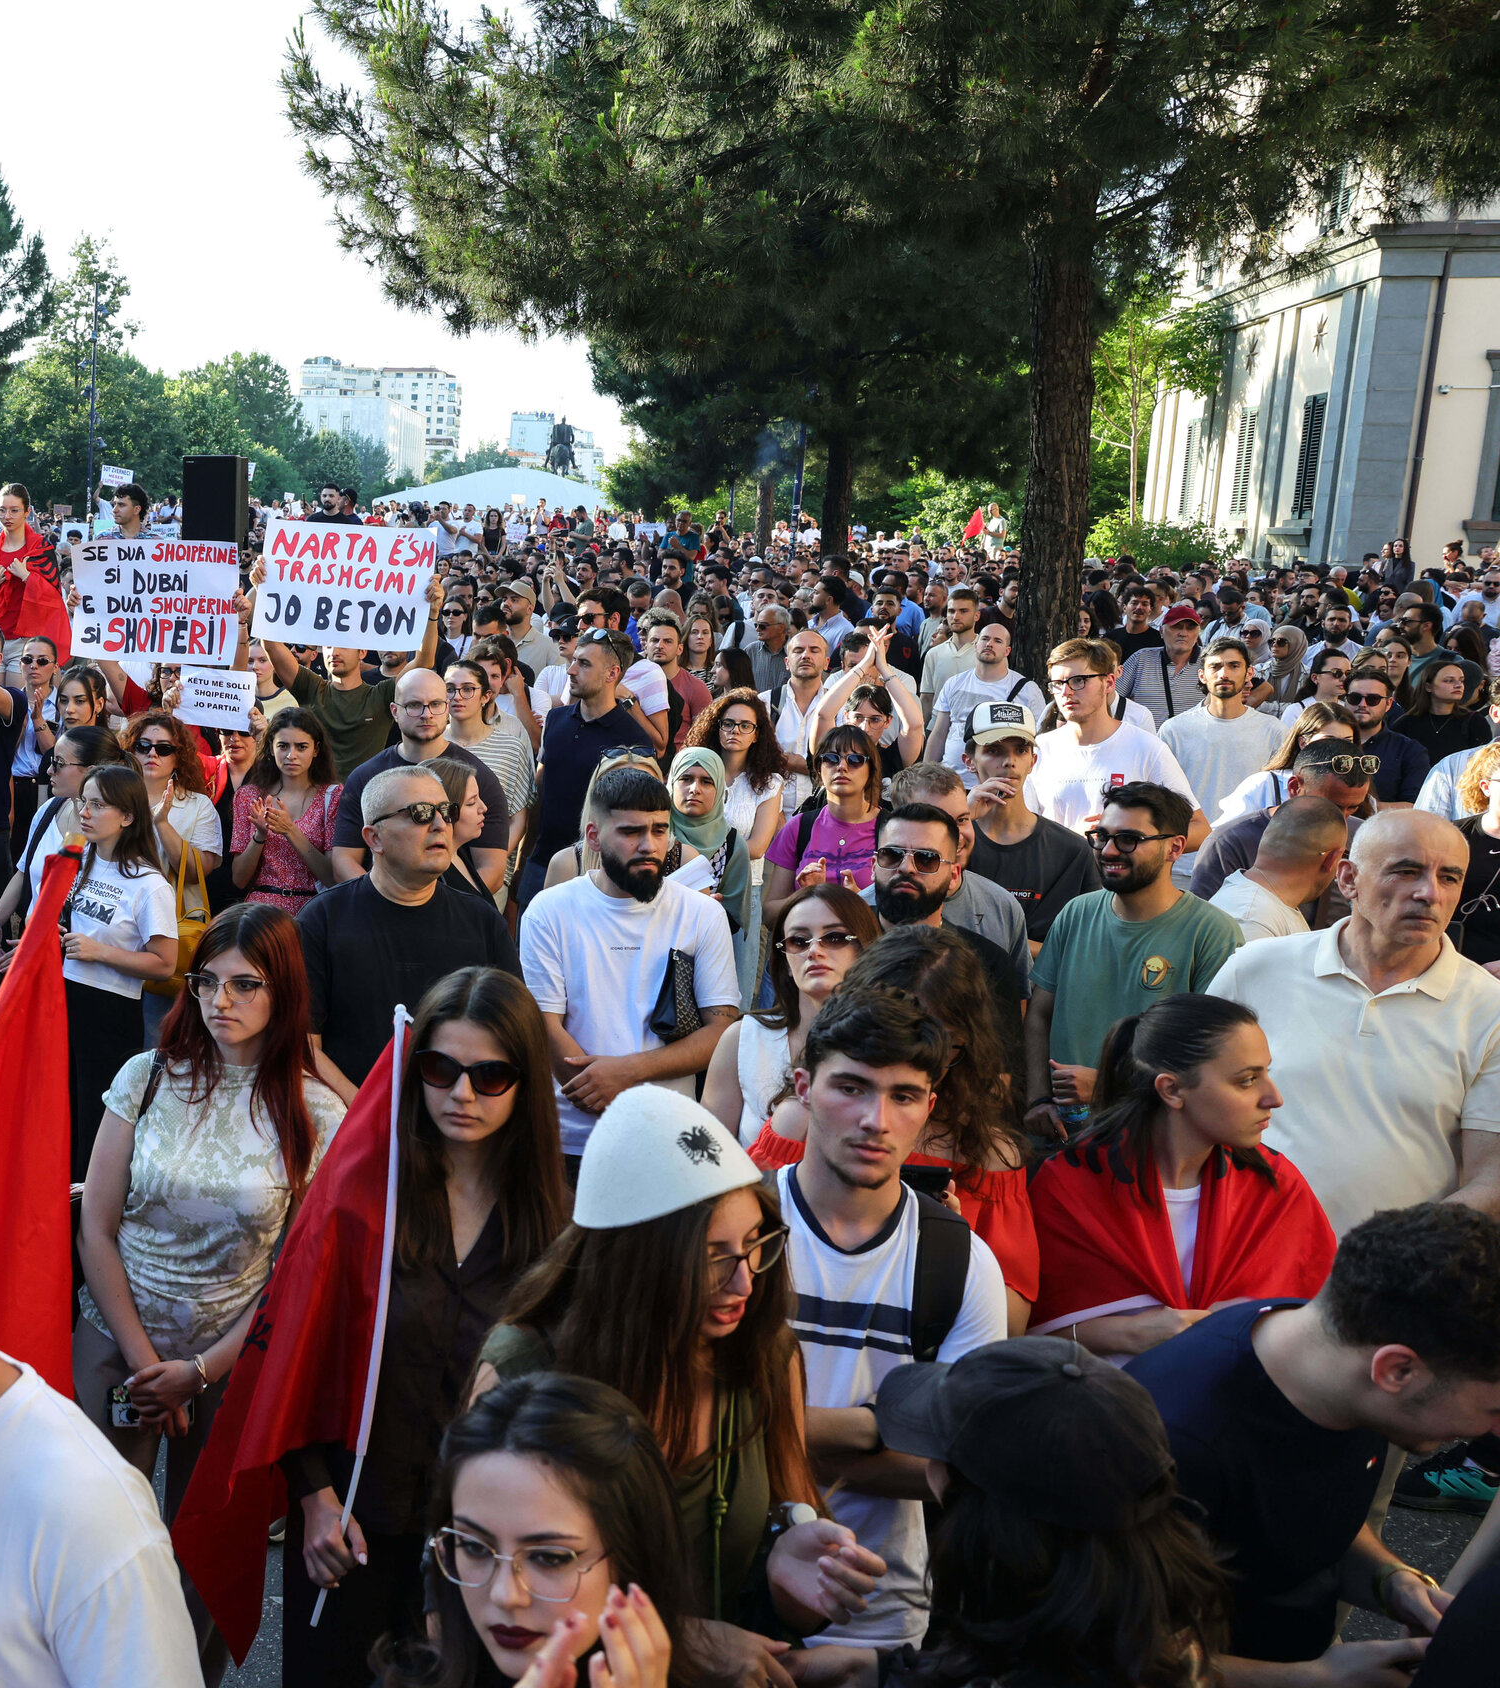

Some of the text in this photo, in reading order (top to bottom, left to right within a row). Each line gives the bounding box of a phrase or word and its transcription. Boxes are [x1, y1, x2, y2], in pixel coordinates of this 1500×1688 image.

[81, 542, 238, 565] SE DUA SHQIPËRINË
[271, 528, 377, 564] NARTA
[274, 559, 416, 596] TRASHGIMI
[82, 594, 96, 614] E
[107, 595, 143, 614] DUA
[264, 592, 416, 636] JO BETON
[226, 681, 251, 691] SOLLI
[207, 702, 240, 713] PARTIA!
[105, 884, 124, 896] MUCH
